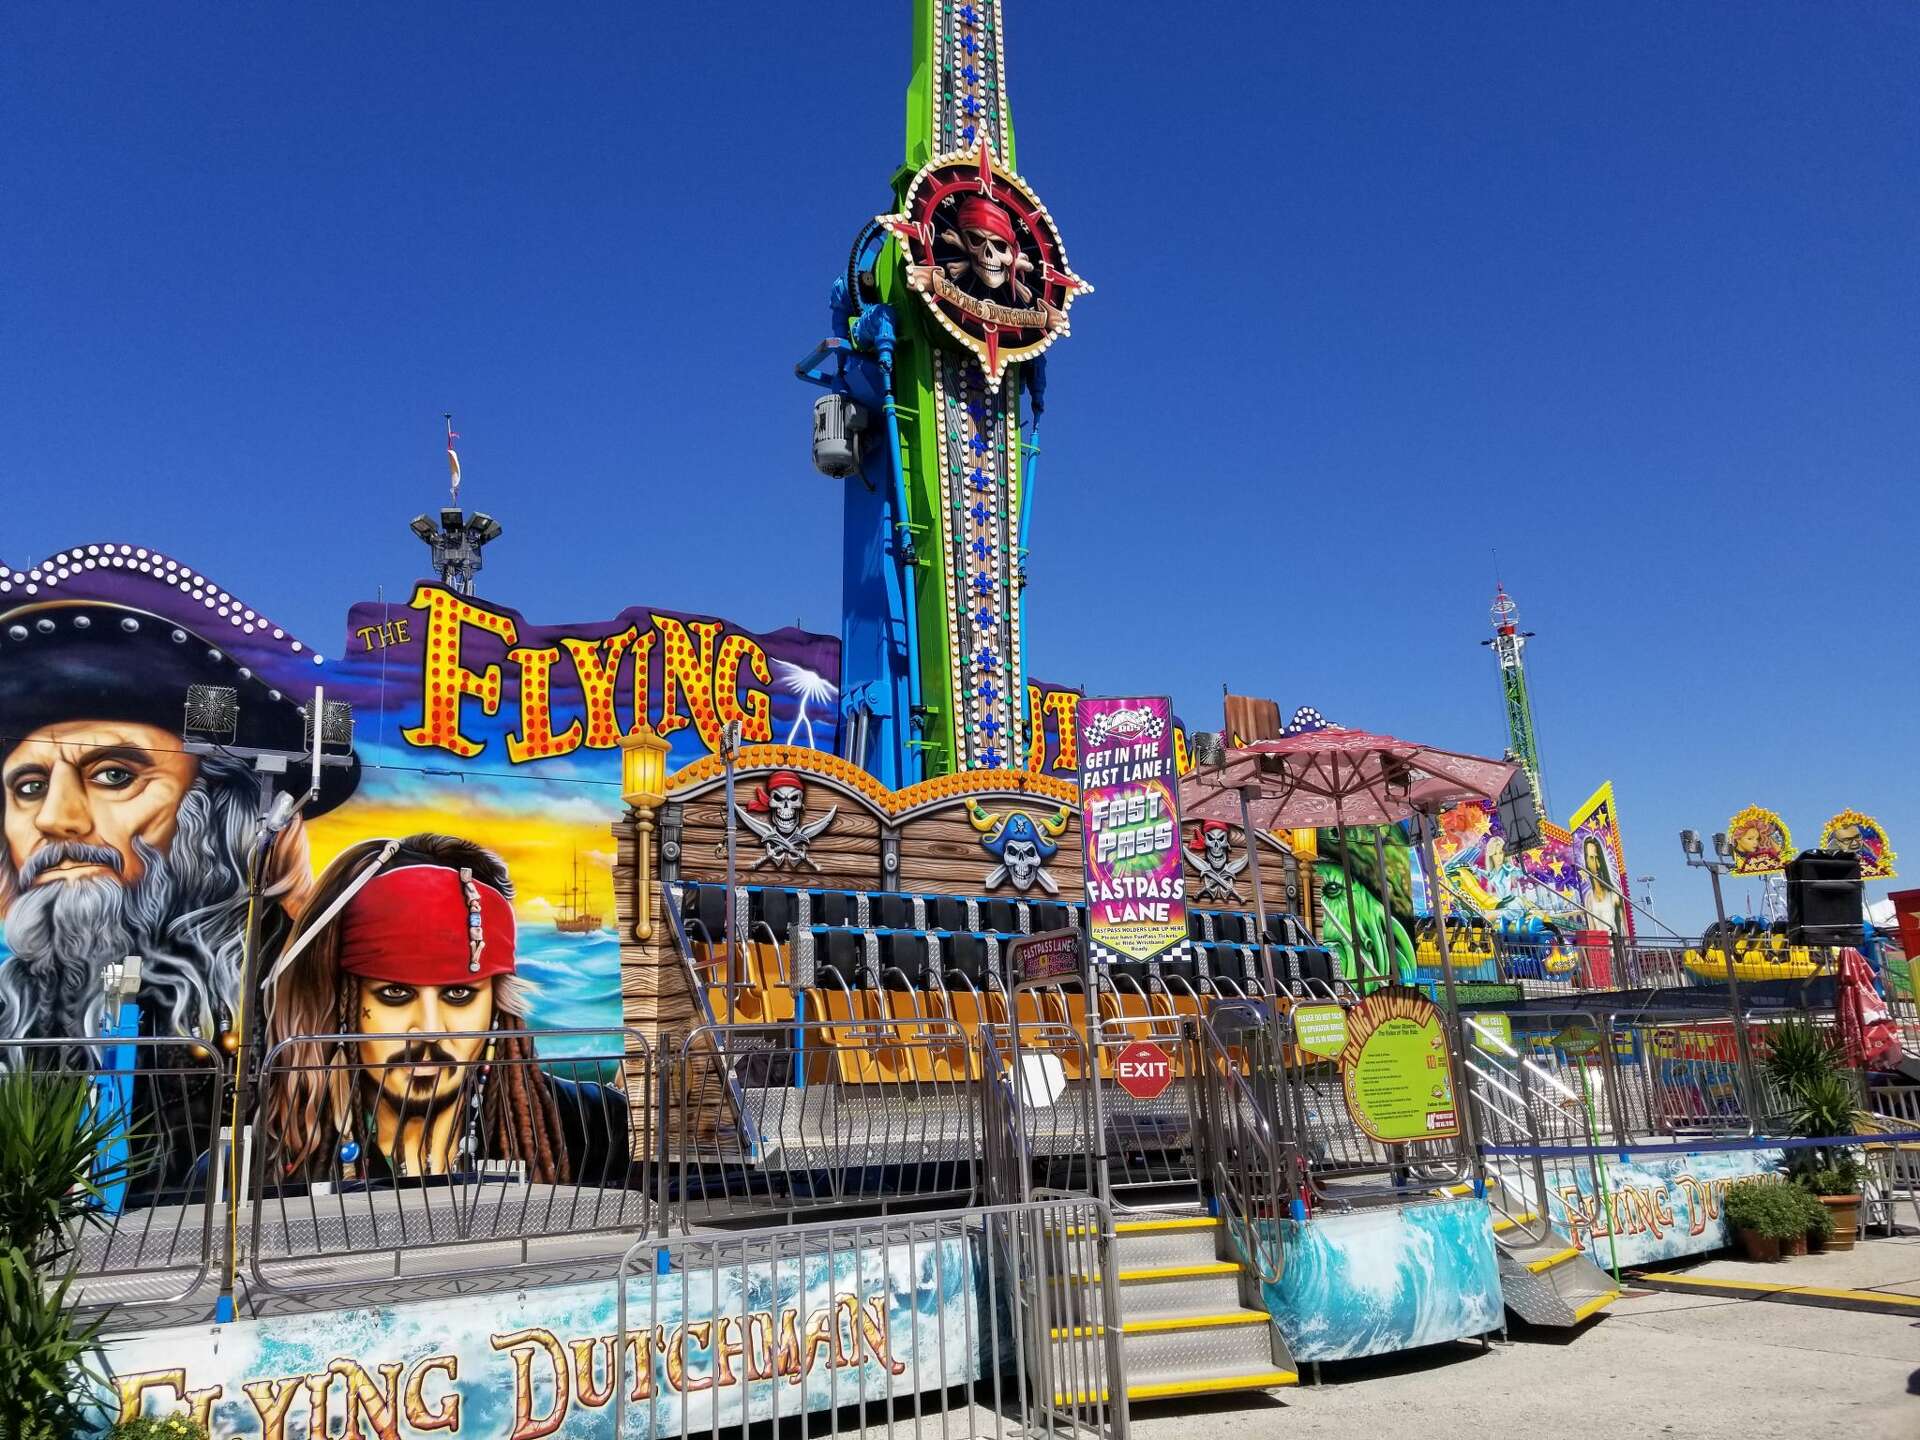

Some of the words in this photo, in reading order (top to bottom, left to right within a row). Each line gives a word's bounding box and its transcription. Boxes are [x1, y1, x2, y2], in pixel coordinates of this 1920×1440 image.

[356, 618, 412, 652] THE
[401, 585, 772, 763] FLYING
[1085, 750, 1112, 770] GET
[1114, 747, 1130, 765] IN
[1133, 742, 1159, 761] THE
[1083, 767, 1119, 789] FAST
[1123, 760, 1162, 782] LANE
[1091, 790, 1163, 832] FAST
[1097, 822, 1174, 864] PASS
[1087, 877, 1185, 903] FASTPASS
[1105, 902, 1170, 924] LANE
[1023, 940, 1053, 960] FASTPASS
[1053, 939, 1071, 952] LANE
[1119, 1062, 1168, 1078] EXIT
[1558, 1184, 1674, 1250] FLYING
[490, 1292, 906, 1439] DUTCHMAN
